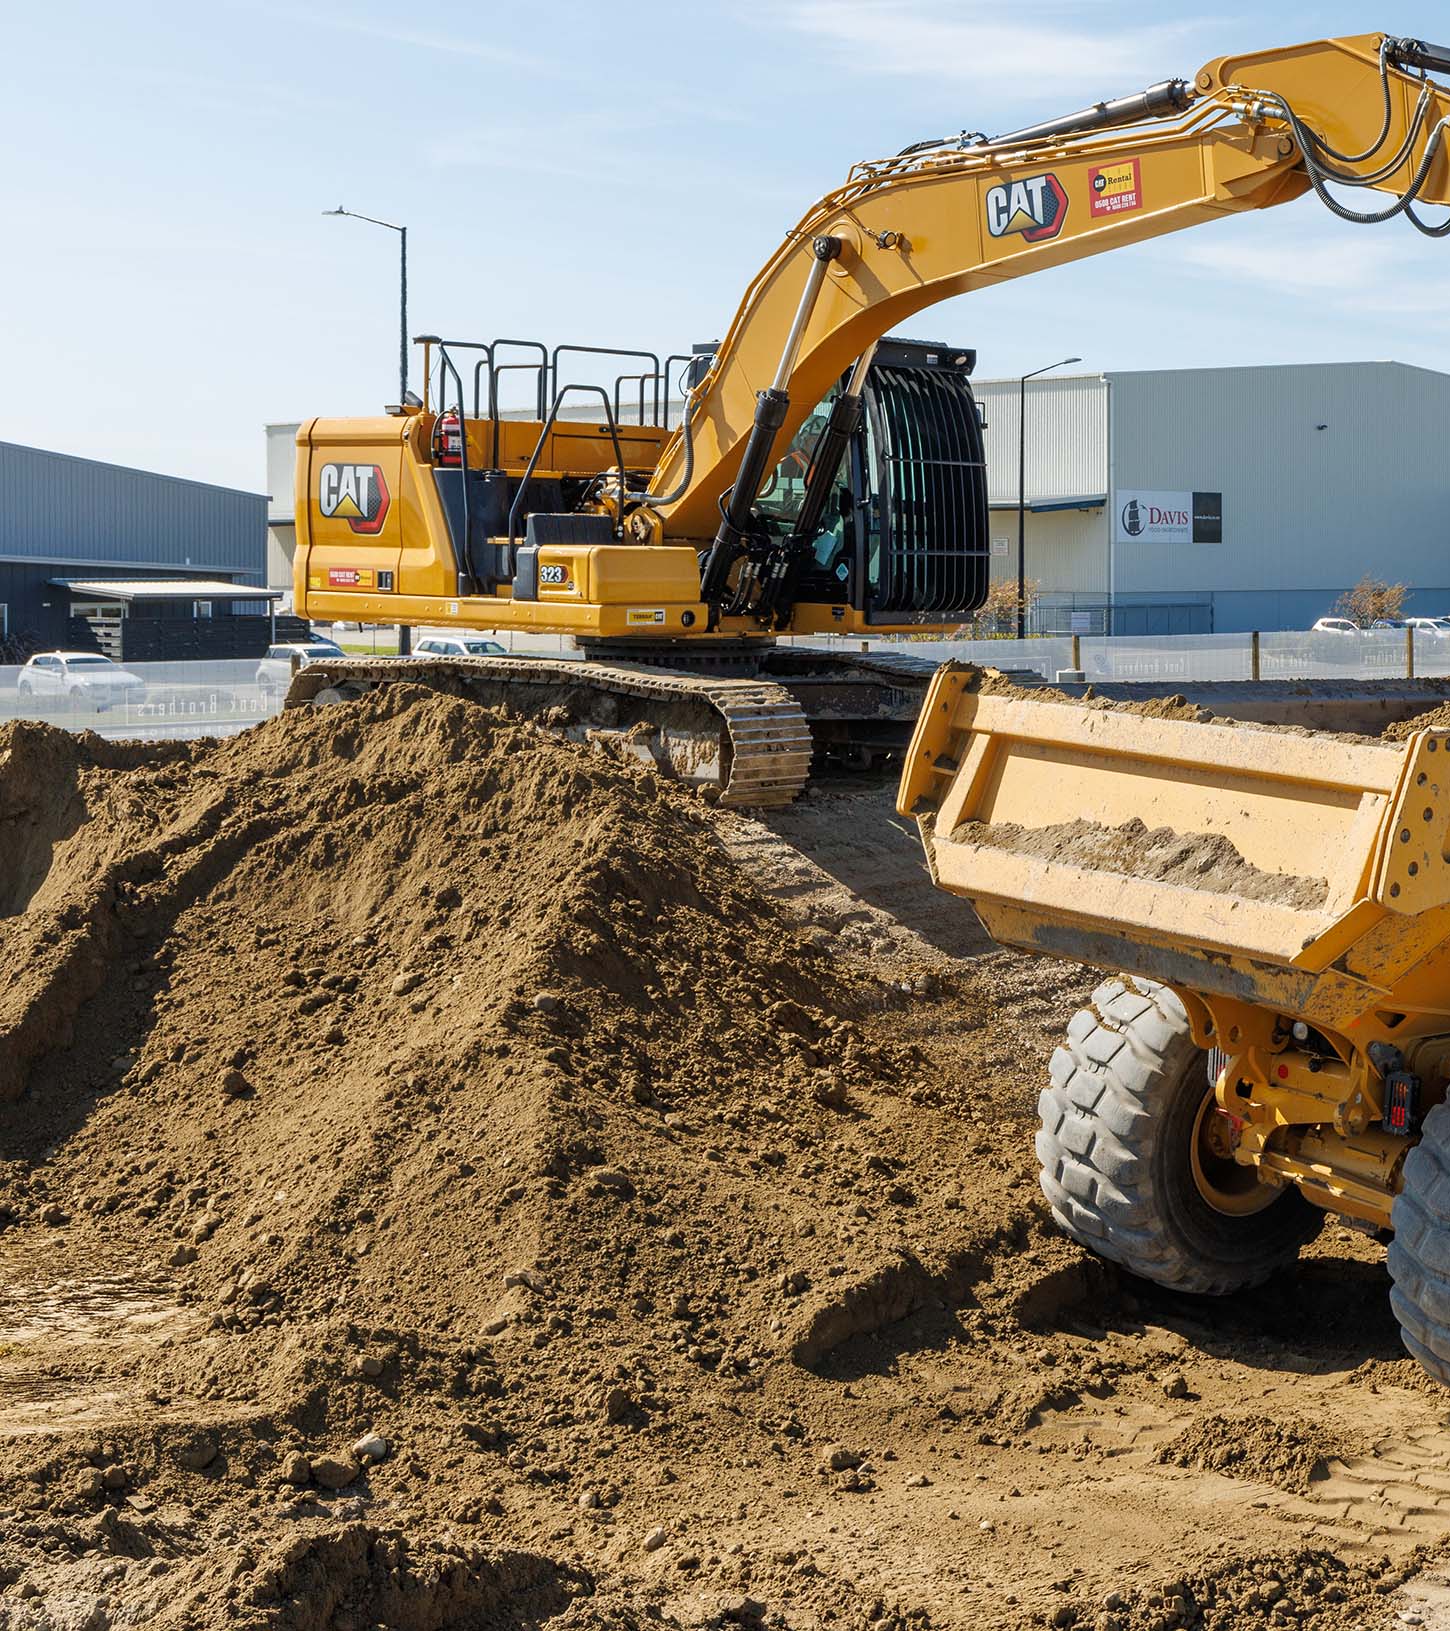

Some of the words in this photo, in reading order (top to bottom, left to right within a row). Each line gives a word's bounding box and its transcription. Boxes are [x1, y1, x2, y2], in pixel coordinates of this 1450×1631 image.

[1094, 179, 1105, 188] CAT
[1107, 172, 1132, 185] Rental
[987, 175, 1047, 236] CAT
[1110, 196, 1121, 205] CAT
[1121, 192, 1137, 202] RENT
[320, 464, 374, 518] CAT
[1149, 507, 1188, 525] DAVIS
[540, 566, 562, 583] 323
